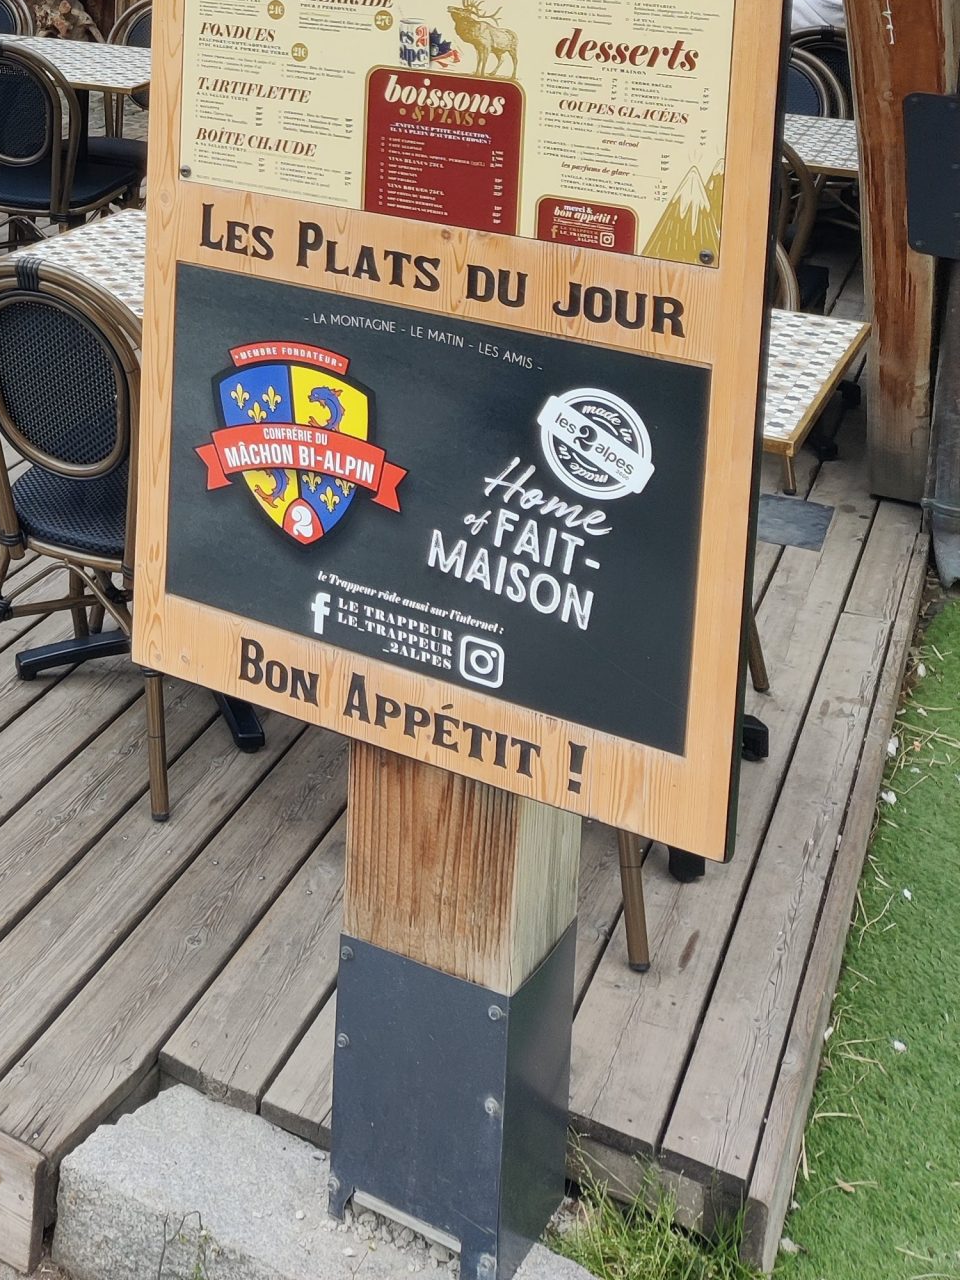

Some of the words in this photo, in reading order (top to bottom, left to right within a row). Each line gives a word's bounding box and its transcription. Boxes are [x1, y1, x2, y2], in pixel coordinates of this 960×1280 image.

[200, 22, 276, 42] FONDUES
[555, 28, 700, 71] desserts
[198, 76, 311, 104] TARTIFLETTE
[384, 75, 506, 116] boissons
[559, 100, 615, 117] COUPES
[617, 105, 689, 125] GLACÉES
[195, 127, 245, 145] BOÎTE
[247, 135, 317, 158] CHAUDE
[554, 206, 572, 217] bon
[574, 212, 611, 223] appétit
[466, 264, 528, 308] DU
[552, 281, 686, 338] JOUR
[240, 346, 277, 360] MEMBRE
[281, 347, 337, 366] FONDATEUR
[313, 313, 328, 326] LA
[330, 314, 397, 333] MONTAGNE
[410, 326, 424, 339] LE
[427, 328, 464, 348] MATIN
[478, 341, 500, 357] LES
[502, 346, 533, 369] AMIS
[263, 427, 312, 443] CONFRÉRIE
[315, 432, 328, 445] DU
[581, 404, 622, 427] made
[224, 442, 293, 468] MÂCHON
[299, 445, 375, 484] BI-ALPIN
[554, 412, 578, 434] les
[573, 425, 598, 452] 2
[595, 443, 635, 475] alpes
[484, 456, 613, 536] Home
[463, 510, 492, 536] of
[318, 571, 328, 581] le
[328, 573, 377, 597] Trappeur
[377, 590, 401, 604] rôde
[402, 598, 429, 612] aussi
[430, 606, 449, 618] sur
[428, 529, 594, 631] MAISON
[338, 598, 359, 612] LE
[363, 605, 453, 642] TRAPPEUR
